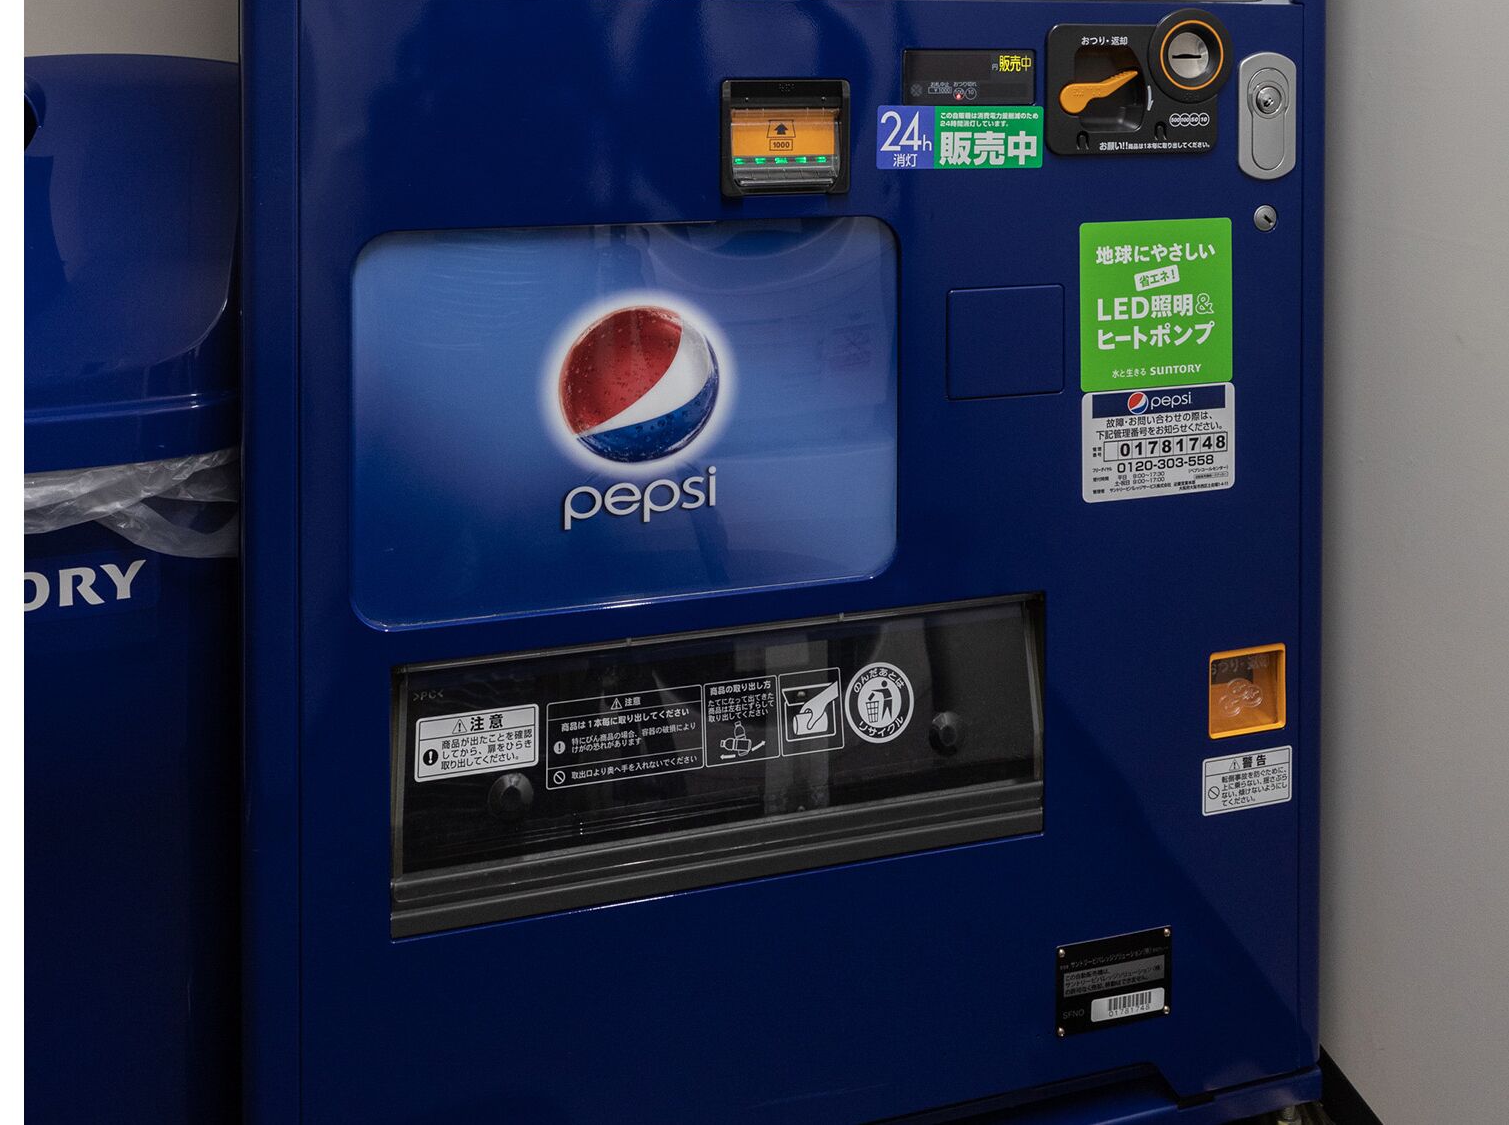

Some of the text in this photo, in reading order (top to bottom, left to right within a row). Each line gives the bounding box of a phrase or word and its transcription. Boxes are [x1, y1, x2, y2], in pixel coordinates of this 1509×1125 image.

[773, 141, 790, 149] 1000
[940, 130, 1037, 166] 販売中
[893, 154, 918, 167] 消灯
[1096, 243, 1216, 265] 地球にやさしい
[1140, 270, 1176, 288] 省エネ!
[1097, 322, 1215, 350] ヒートポンプ
[1112, 364, 1202, 379] 水と生きる SUNTORY
[1151, 392, 1192, 410] pepsi
[1096, 421, 1223, 440] 下記管理番号をお知らせください。
[1120, 435, 1225, 457] 01781748
[1117, 455, 1214, 473] 0120-303-558
[561, 465, 718, 531] pepsi
[710, 681, 771, 696] 商品の取り出し方
[853, 667, 905, 693] のんだあとは
[708, 693, 775, 708] たてになって出てきた
[708, 700, 775, 715] 商品は左右にずらして
[469, 713, 504, 731] 注意
[708, 709, 769, 723] 取り出してください
[858, 716, 904, 738] リサイクル
[441, 729, 533, 750] 商品が出たことを確認
[442, 740, 533, 759] してから、扉をひらき
[441, 753, 521, 770] 取り出してください。
[1242, 755, 1267, 768] 警告
[1222, 797, 1255, 806] てください。
